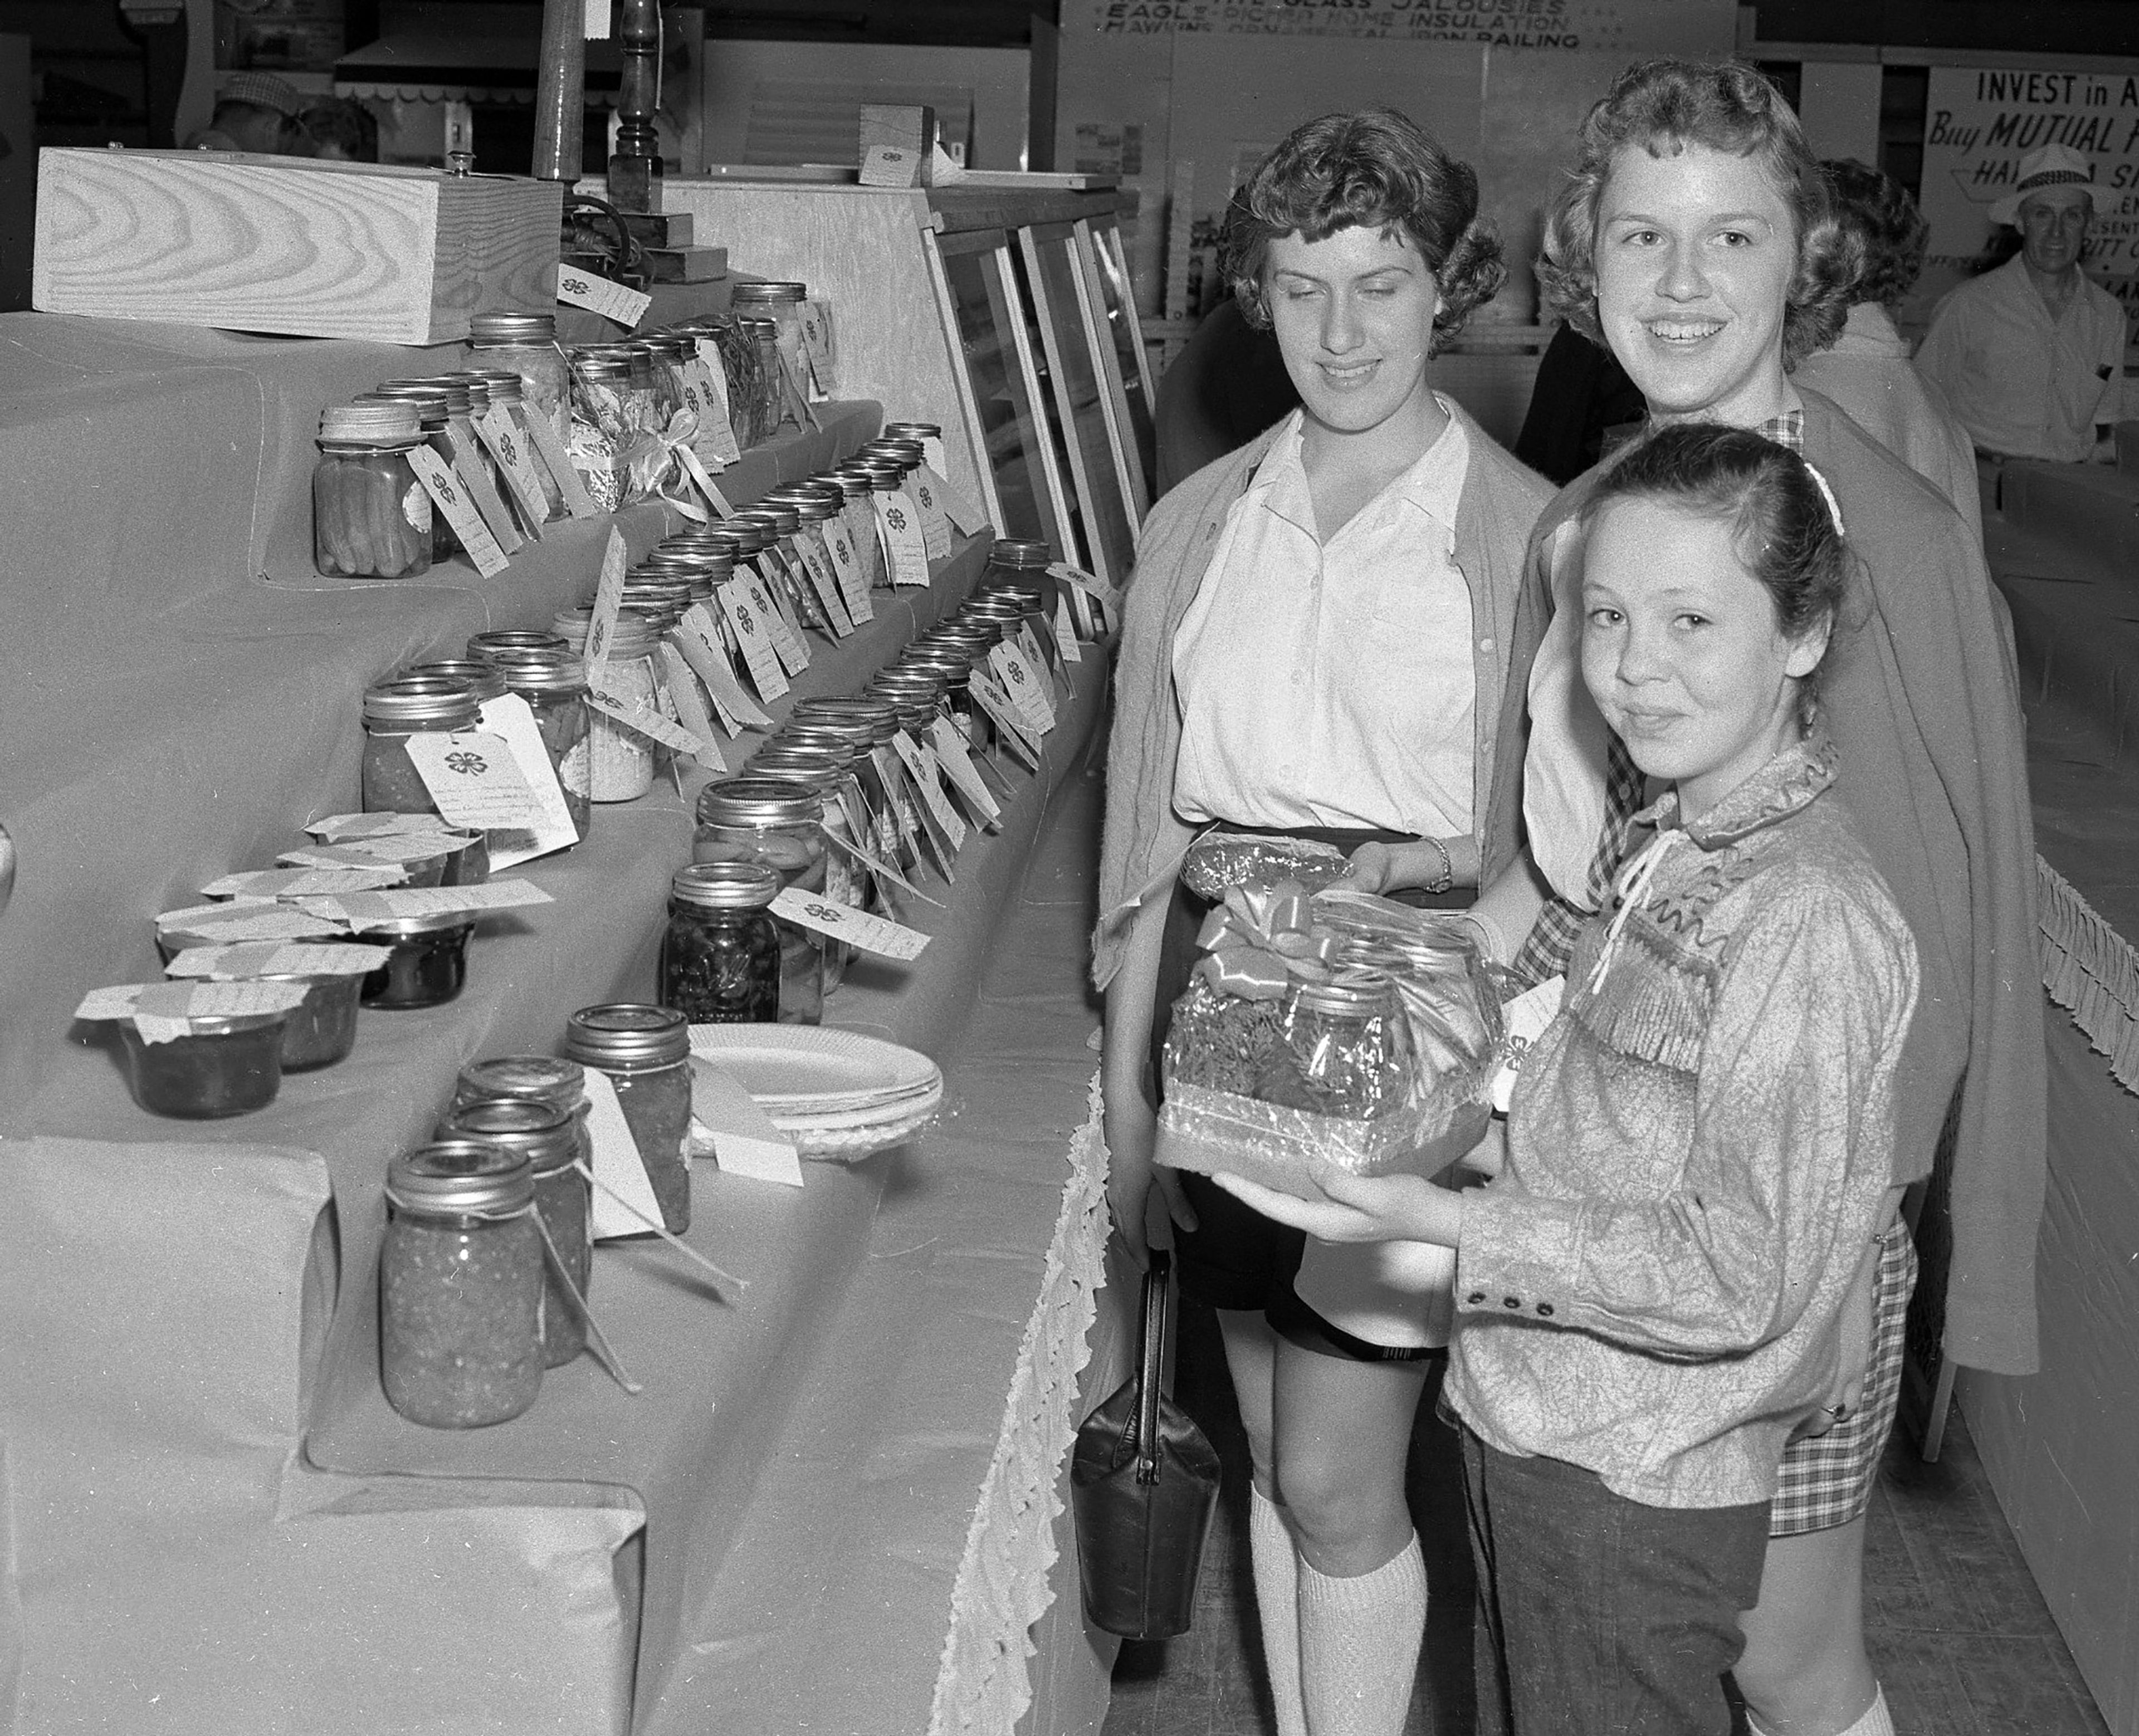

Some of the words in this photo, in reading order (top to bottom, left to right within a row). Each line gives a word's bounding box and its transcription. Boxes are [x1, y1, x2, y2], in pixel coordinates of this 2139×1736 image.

[1409, 13, 1570, 31] INSULATION
[1476, 32, 1580, 48] RAILING
[1977, 72, 2077, 105] INVEST
[2086, 76, 2108, 106] in
[1928, 110, 1981, 157] Buy
[1985, 113, 2113, 153] MUTUAL
